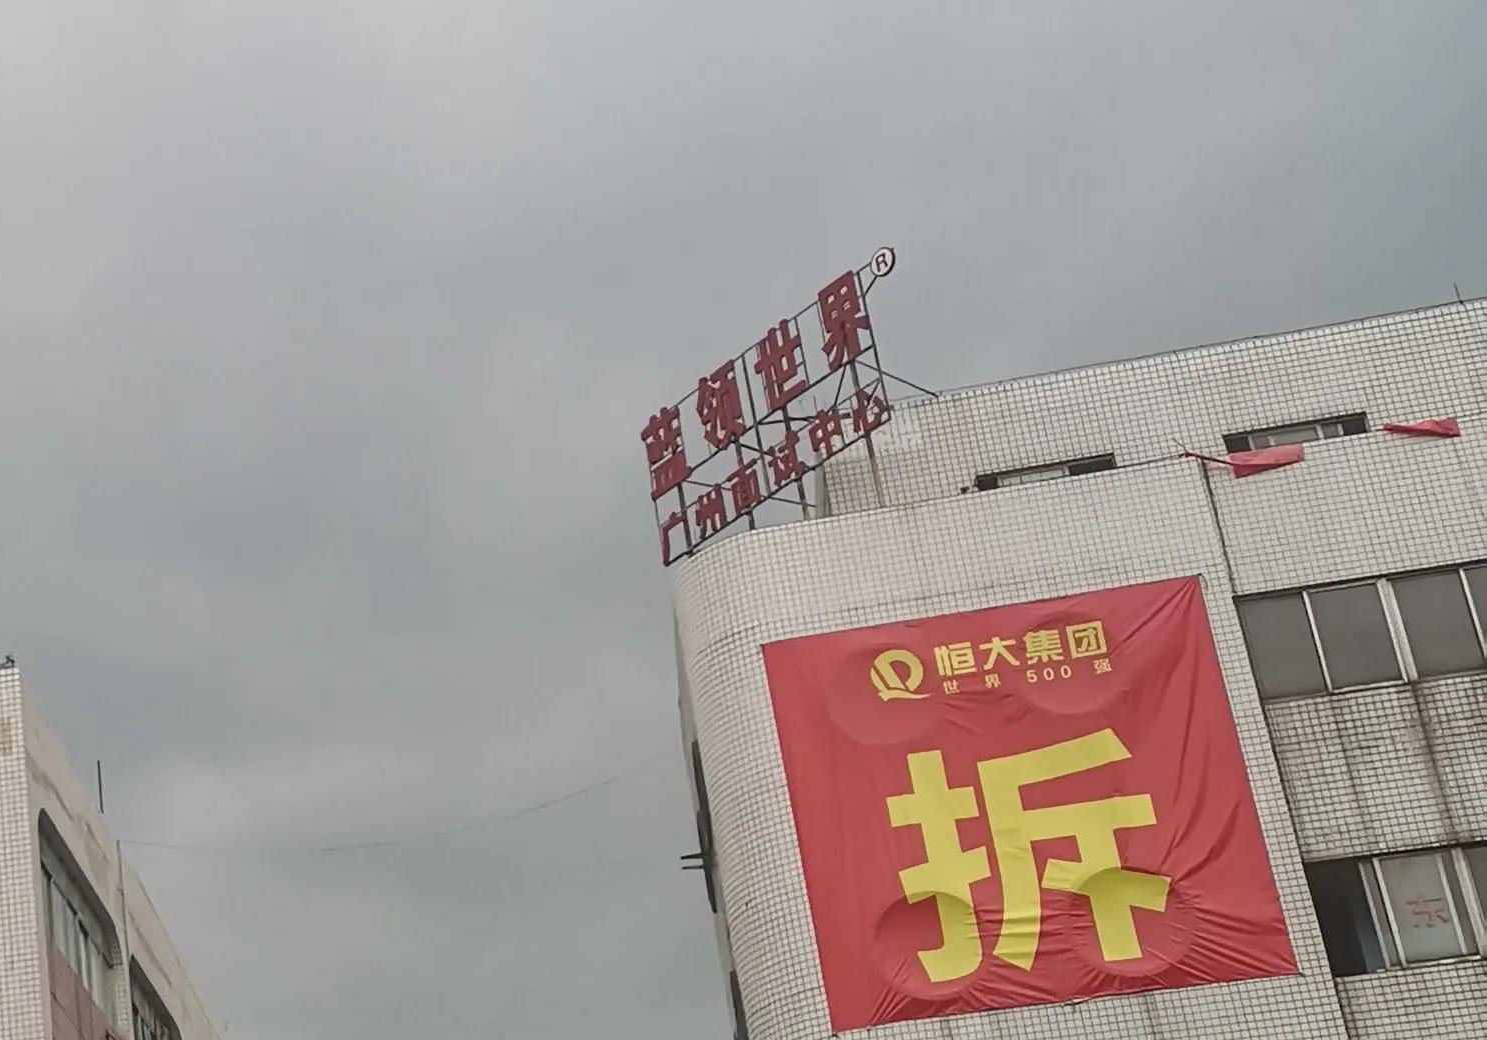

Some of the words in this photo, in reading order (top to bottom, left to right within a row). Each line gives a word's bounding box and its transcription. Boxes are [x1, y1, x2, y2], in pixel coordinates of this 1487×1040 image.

[933, 620, 1108, 677] 恒大集团
[886, 727, 1173, 984] 拆
